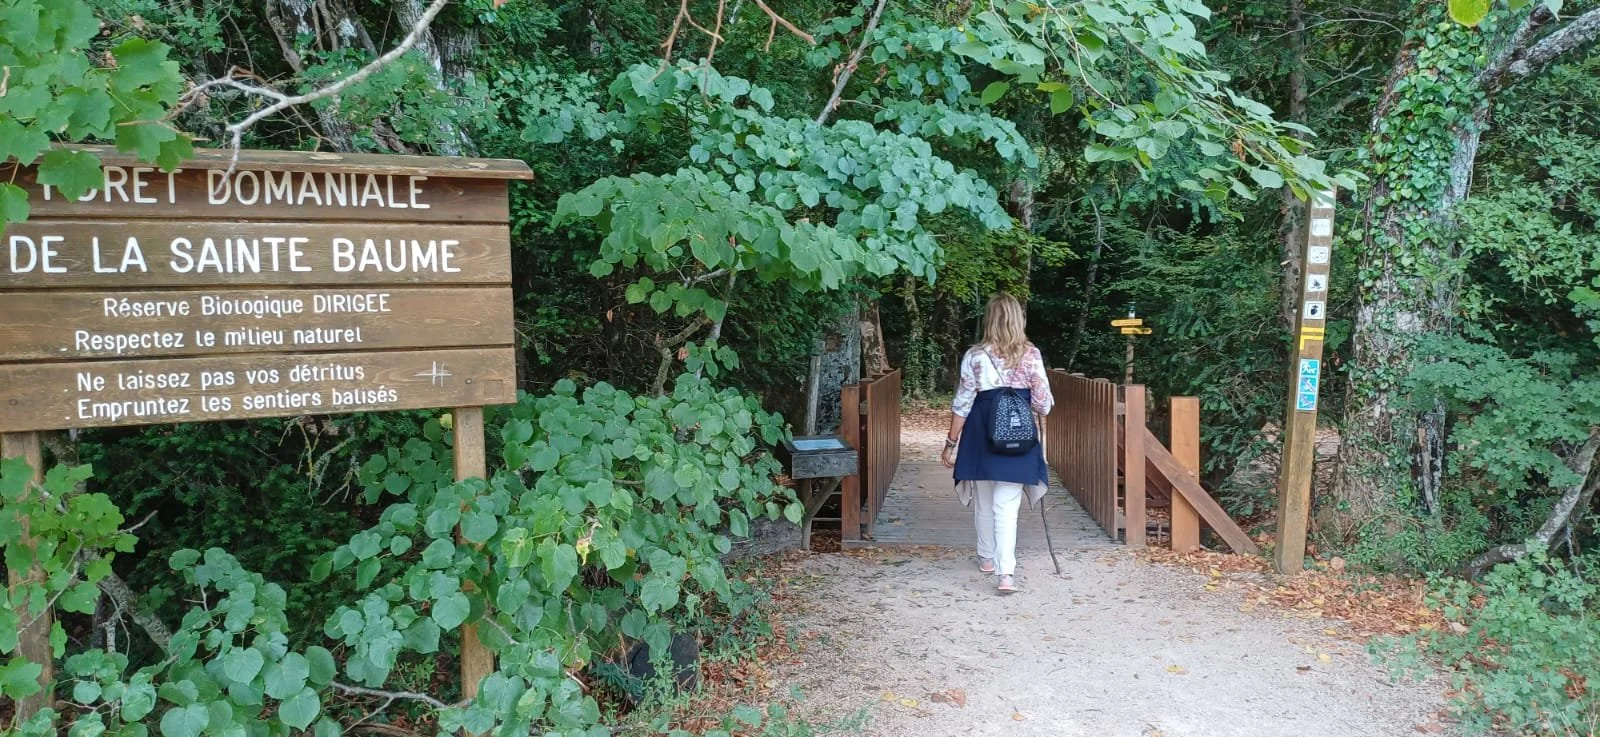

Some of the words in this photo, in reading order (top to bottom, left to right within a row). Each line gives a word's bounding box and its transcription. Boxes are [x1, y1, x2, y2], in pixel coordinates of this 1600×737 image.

[43, 166, 183, 204] RET
[207, 169, 431, 209] DOMANIALE
[9, 235, 67, 273] DE
[92, 236, 148, 273] LA
[169, 237, 313, 273] SAINTE
[332, 237, 461, 273] BAUME
[104, 298, 190, 317] Réserve
[201, 296, 304, 318] Biologique
[313, 294, 391, 313] DIRIGEE
[75, 330, 184, 353] Respectez
[196, 330, 214, 347] le
[225, 327, 283, 346] milieu
[293, 327, 362, 344] naturel
[77, 372, 105, 392] Ne
[118, 370, 190, 390] laissez
[201, 370, 235, 390] pas
[246, 368, 279, 384] vos
[289, 363, 365, 382] détritus
[78, 398, 190, 421] Empruntez
[202, 396, 232, 412] les
[242, 389, 322, 410] sentiers
[332, 385, 398, 406] balisés
